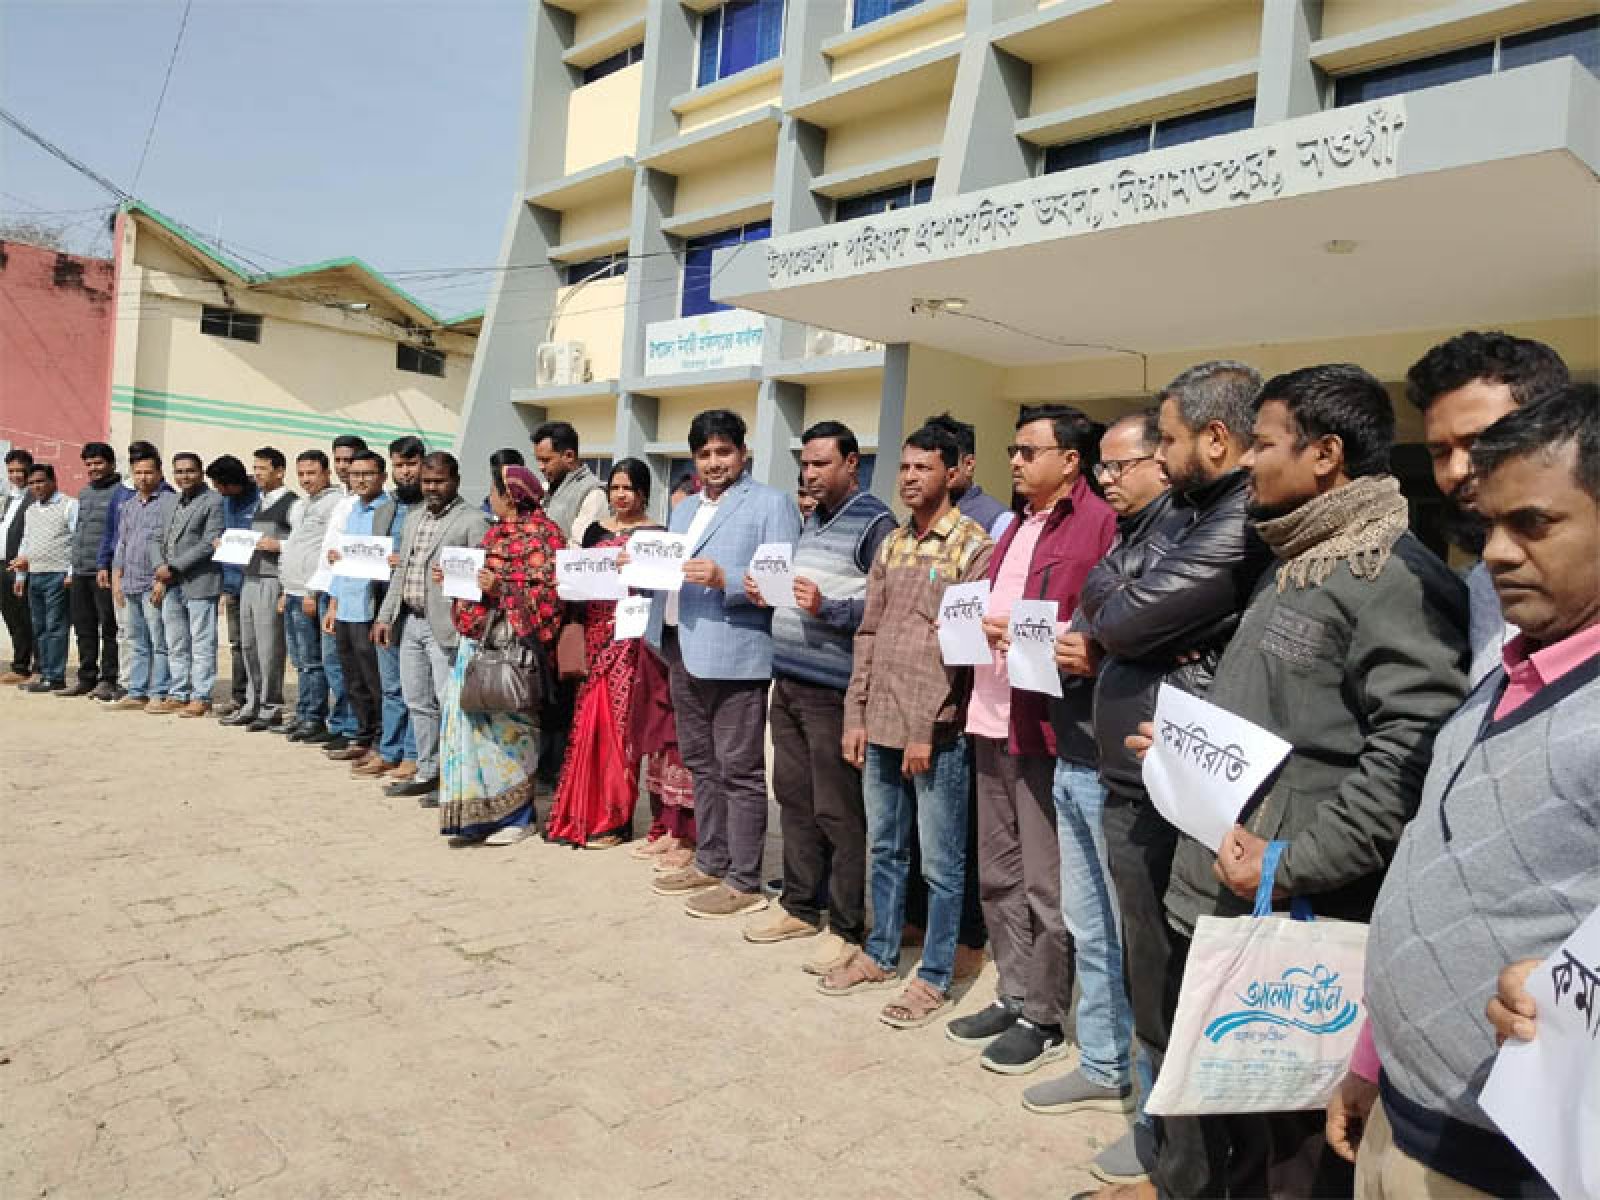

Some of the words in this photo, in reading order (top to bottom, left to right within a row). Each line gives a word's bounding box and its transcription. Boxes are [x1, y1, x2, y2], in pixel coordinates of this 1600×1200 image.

[768, 241, 840, 278] উপজেলা
[847, 225, 911, 267] পরিষদ
[916, 198, 1025, 255] প্রশাসনিক
[1296, 108, 1405, 177] নওগাঁ
[1162, 719, 1251, 783] কর্মবিরতি
